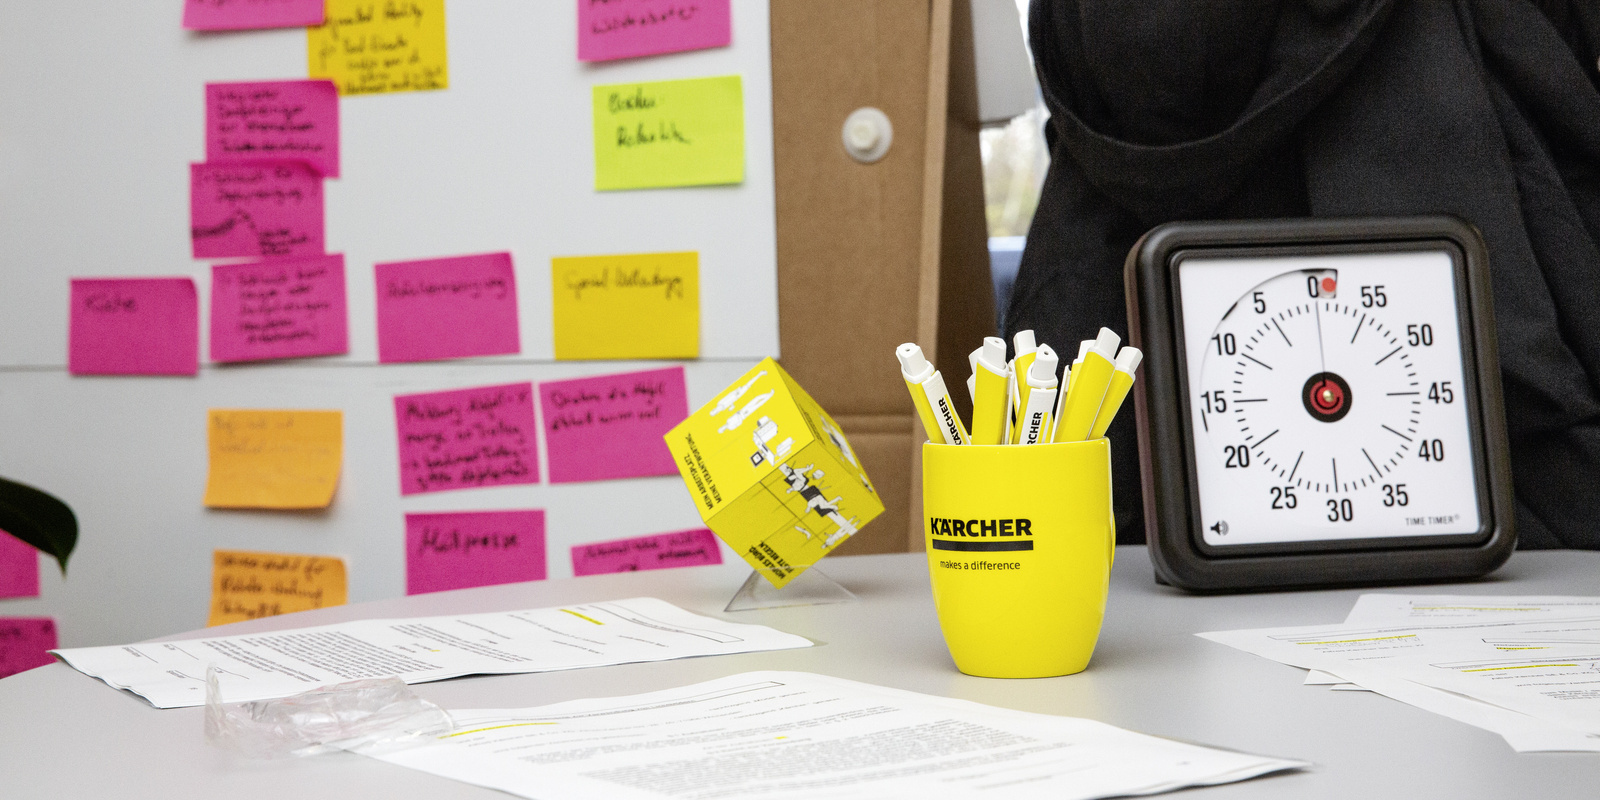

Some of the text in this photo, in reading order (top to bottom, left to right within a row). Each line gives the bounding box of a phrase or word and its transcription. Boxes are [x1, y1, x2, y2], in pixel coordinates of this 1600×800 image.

[1307, 276, 1319, 298] 0
[1360, 285, 1388, 308] 55
[1253, 291, 1267, 315] 5
[1212, 333, 1237, 356] 10
[1407, 323, 1434, 347] 50
[1201, 390, 1227, 414] 15
[1428, 381, 1454, 404] 45
[1224, 445, 1251, 468] 20
[1418, 439, 1445, 462] 40
[703, 493, 714, 510] MEIN
[709, 484, 722, 504] MEINE
[1270, 486, 1298, 510] 25
[1382, 484, 1409, 507] 35
[1326, 498, 1353, 522] 30
[1405, 517, 1425, 526] TIME
[930, 517, 1033, 538] KÄRCHER
[940, 559, 1021, 571] makes a difference
